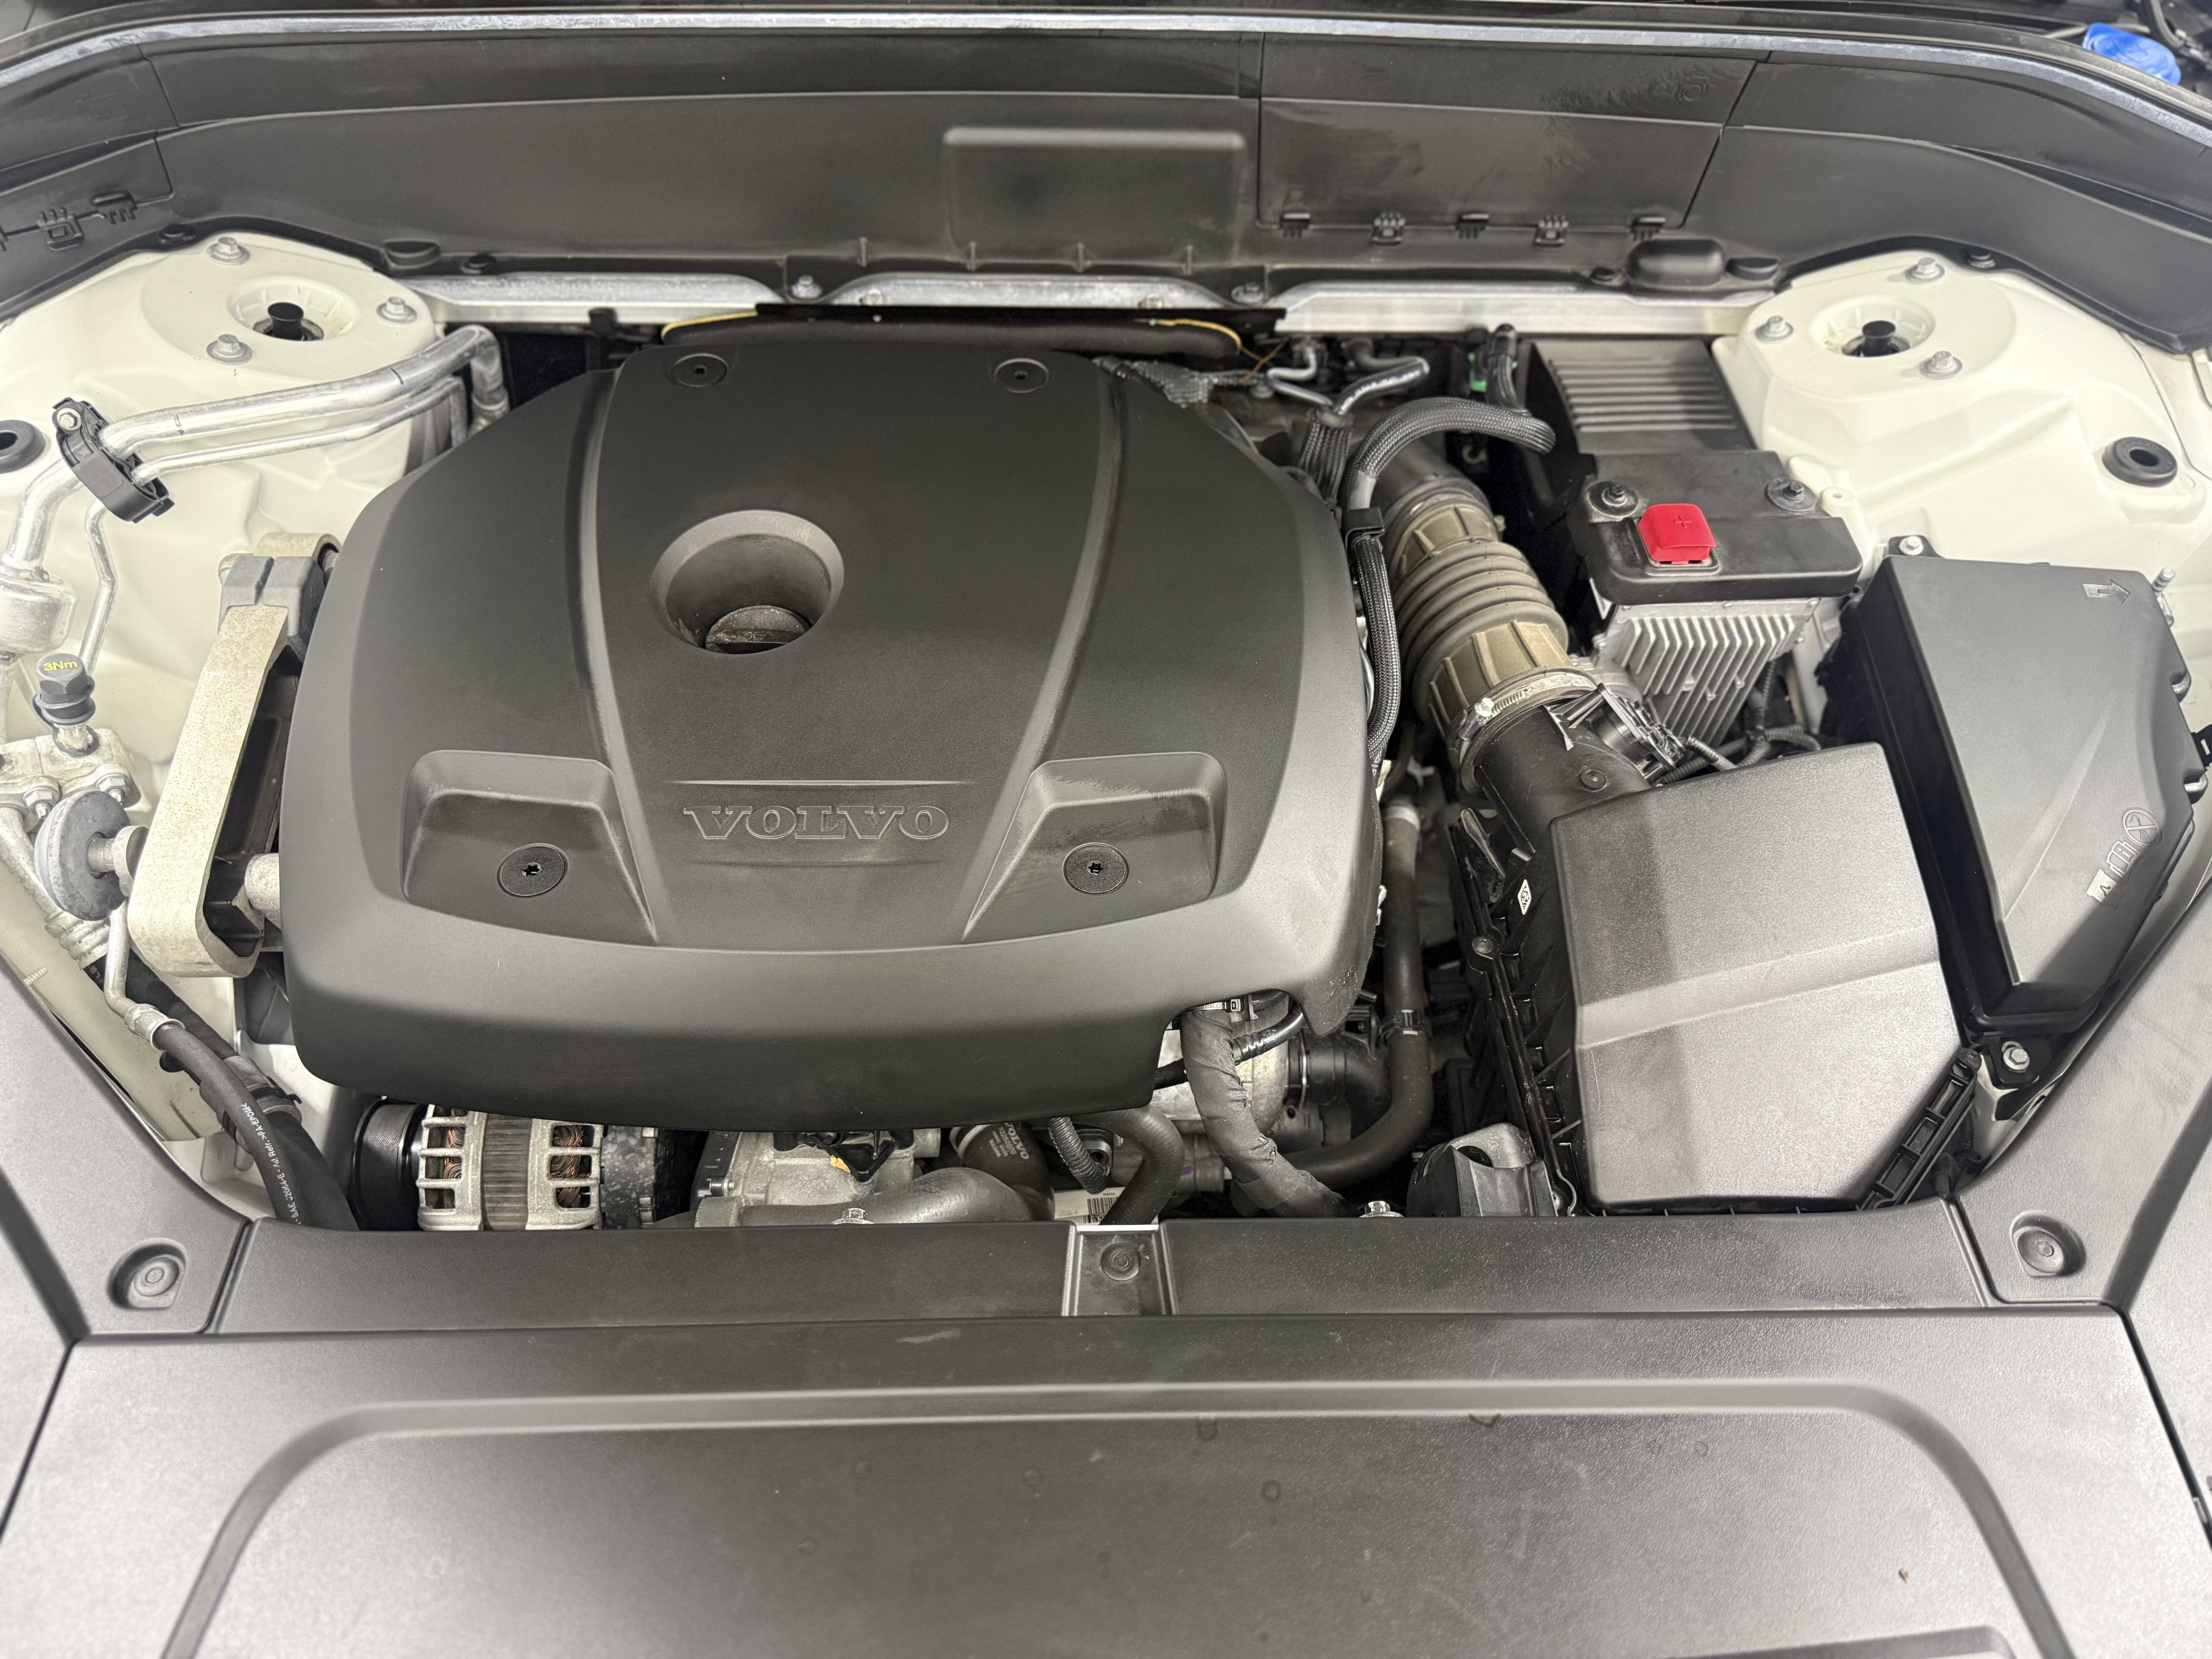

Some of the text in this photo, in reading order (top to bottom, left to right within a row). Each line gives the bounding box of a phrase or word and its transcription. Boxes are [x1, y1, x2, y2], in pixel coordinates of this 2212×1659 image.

[43, 661, 77, 671] 3Nm
[684, 806, 948, 839] VOLVO
[998, 1126, 1016, 1154] 32252070
[1004, 1123, 1029, 1159] VOLVO
